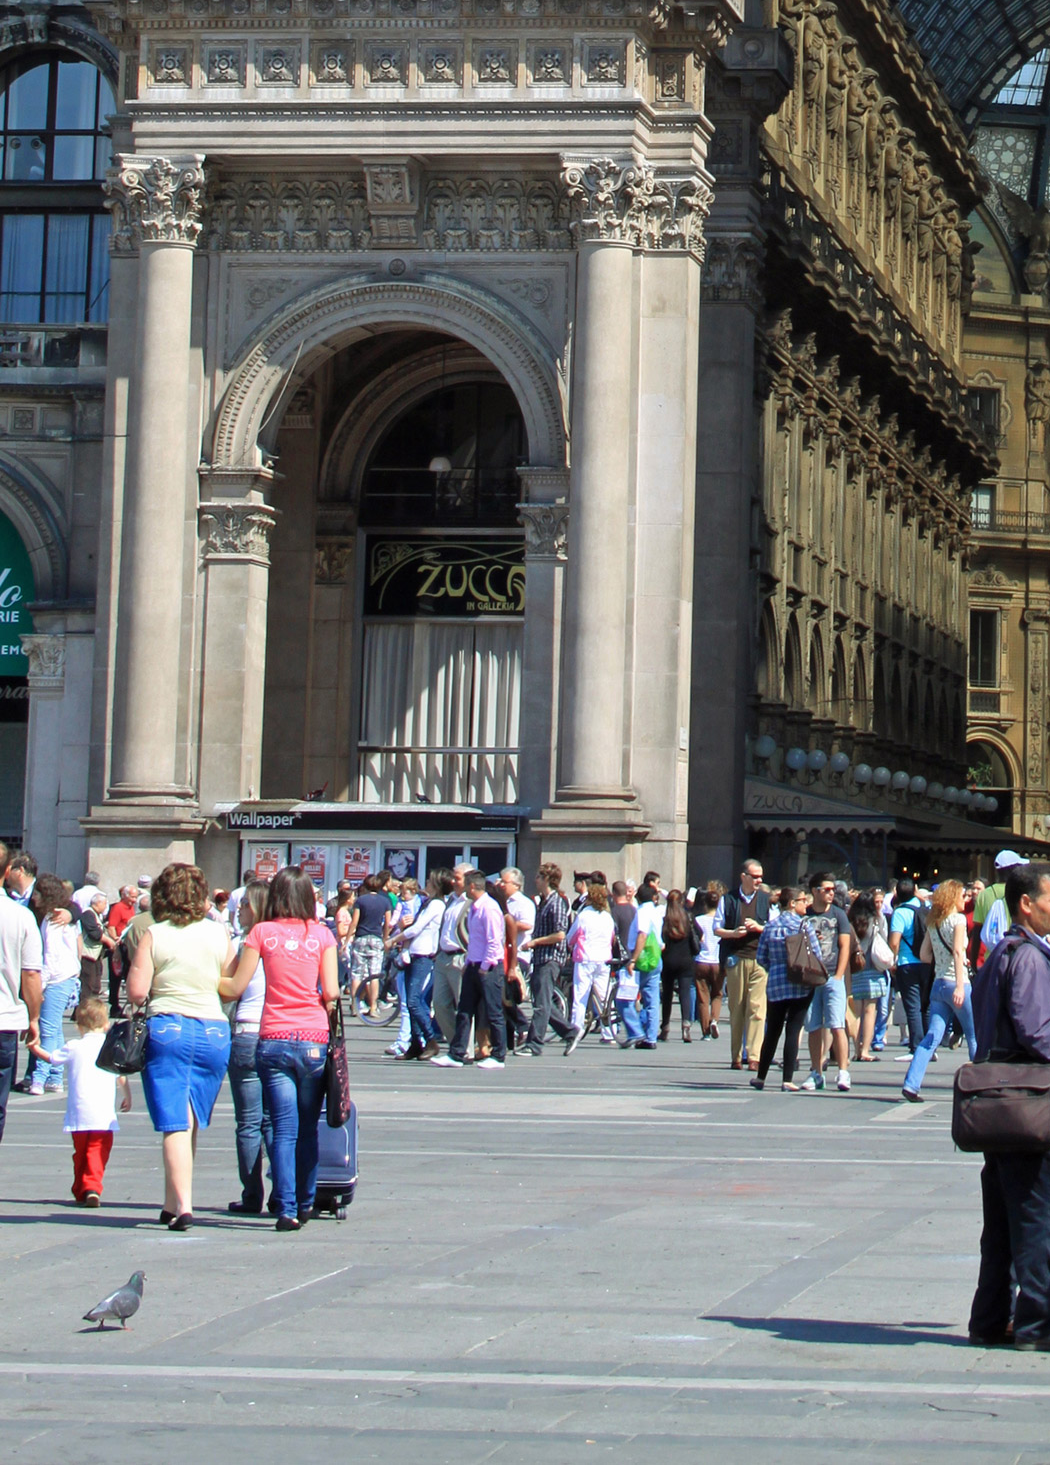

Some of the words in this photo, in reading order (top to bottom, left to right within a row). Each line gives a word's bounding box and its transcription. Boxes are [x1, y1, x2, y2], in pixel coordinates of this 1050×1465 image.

[467, 602, 475, 611] IN
[478, 602, 515, 611] GALLERIA
[753, 794, 803, 813] ZUCCA
